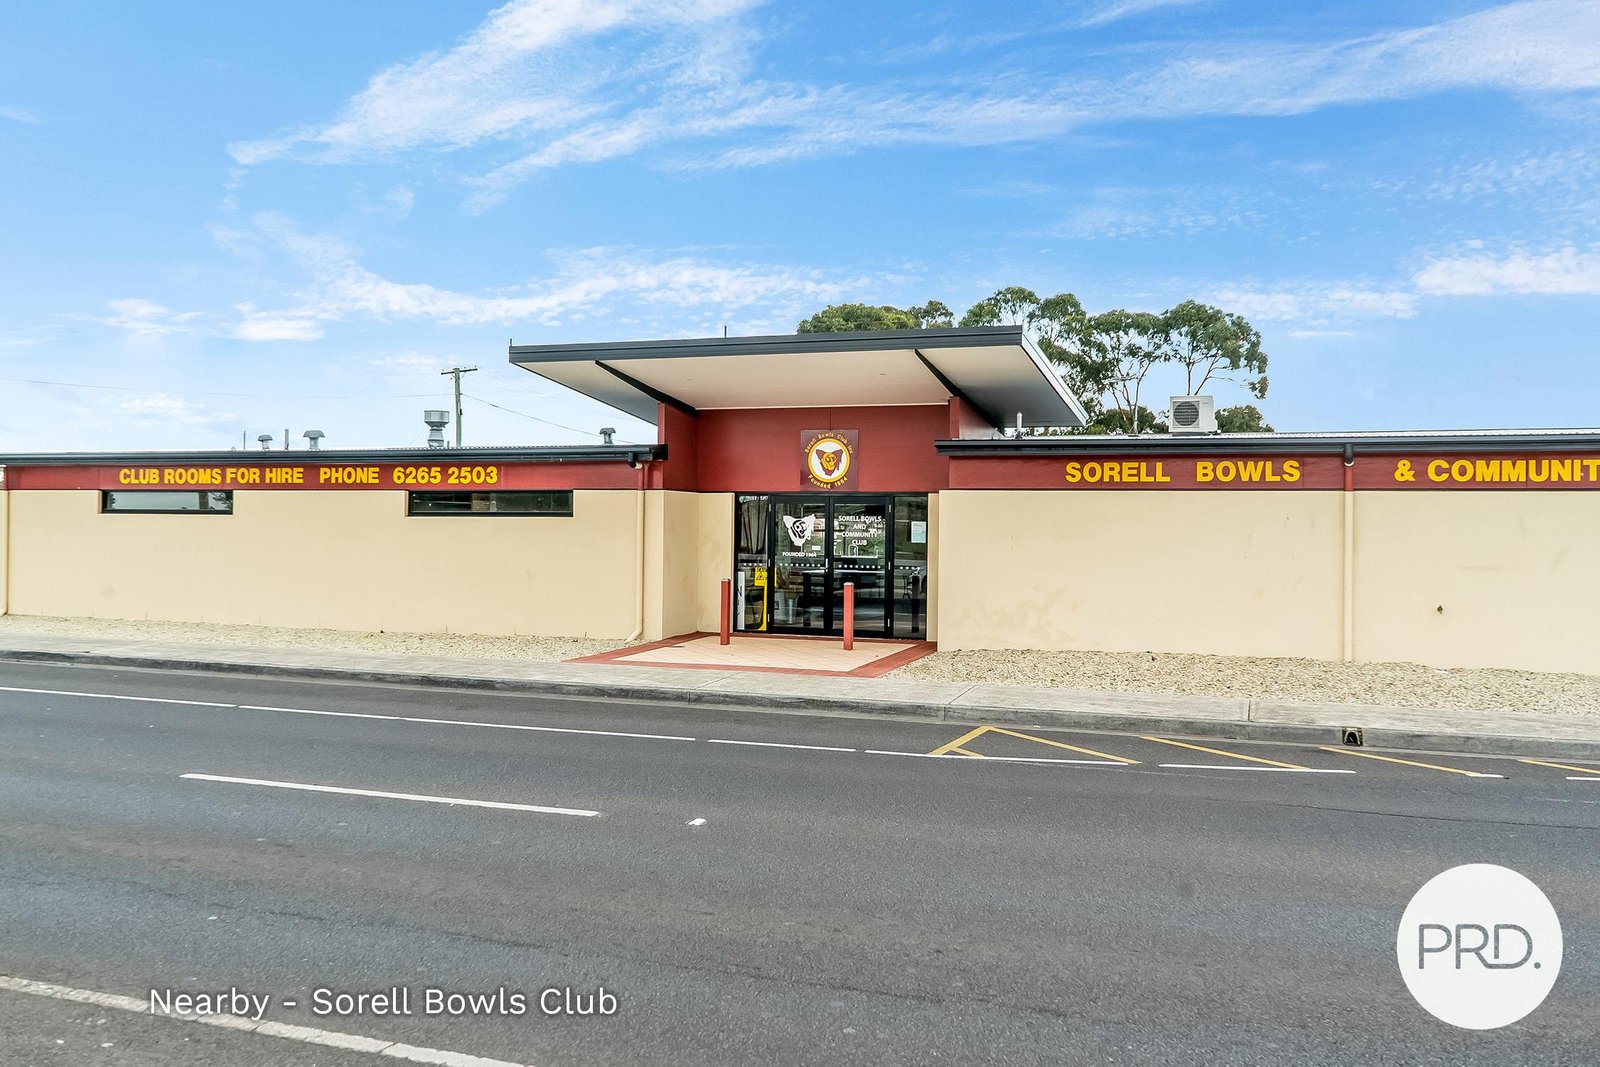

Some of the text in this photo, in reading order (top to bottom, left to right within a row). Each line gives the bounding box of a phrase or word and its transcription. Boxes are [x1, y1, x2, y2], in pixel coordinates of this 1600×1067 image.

[119, 466, 498, 485] CLUB ROOMS FOR HIRE PHONE 6265 2503
[1065, 461, 1171, 482] SORELL
[1196, 460, 1301, 482] BOWLS
[1394, 459, 1416, 482] &
